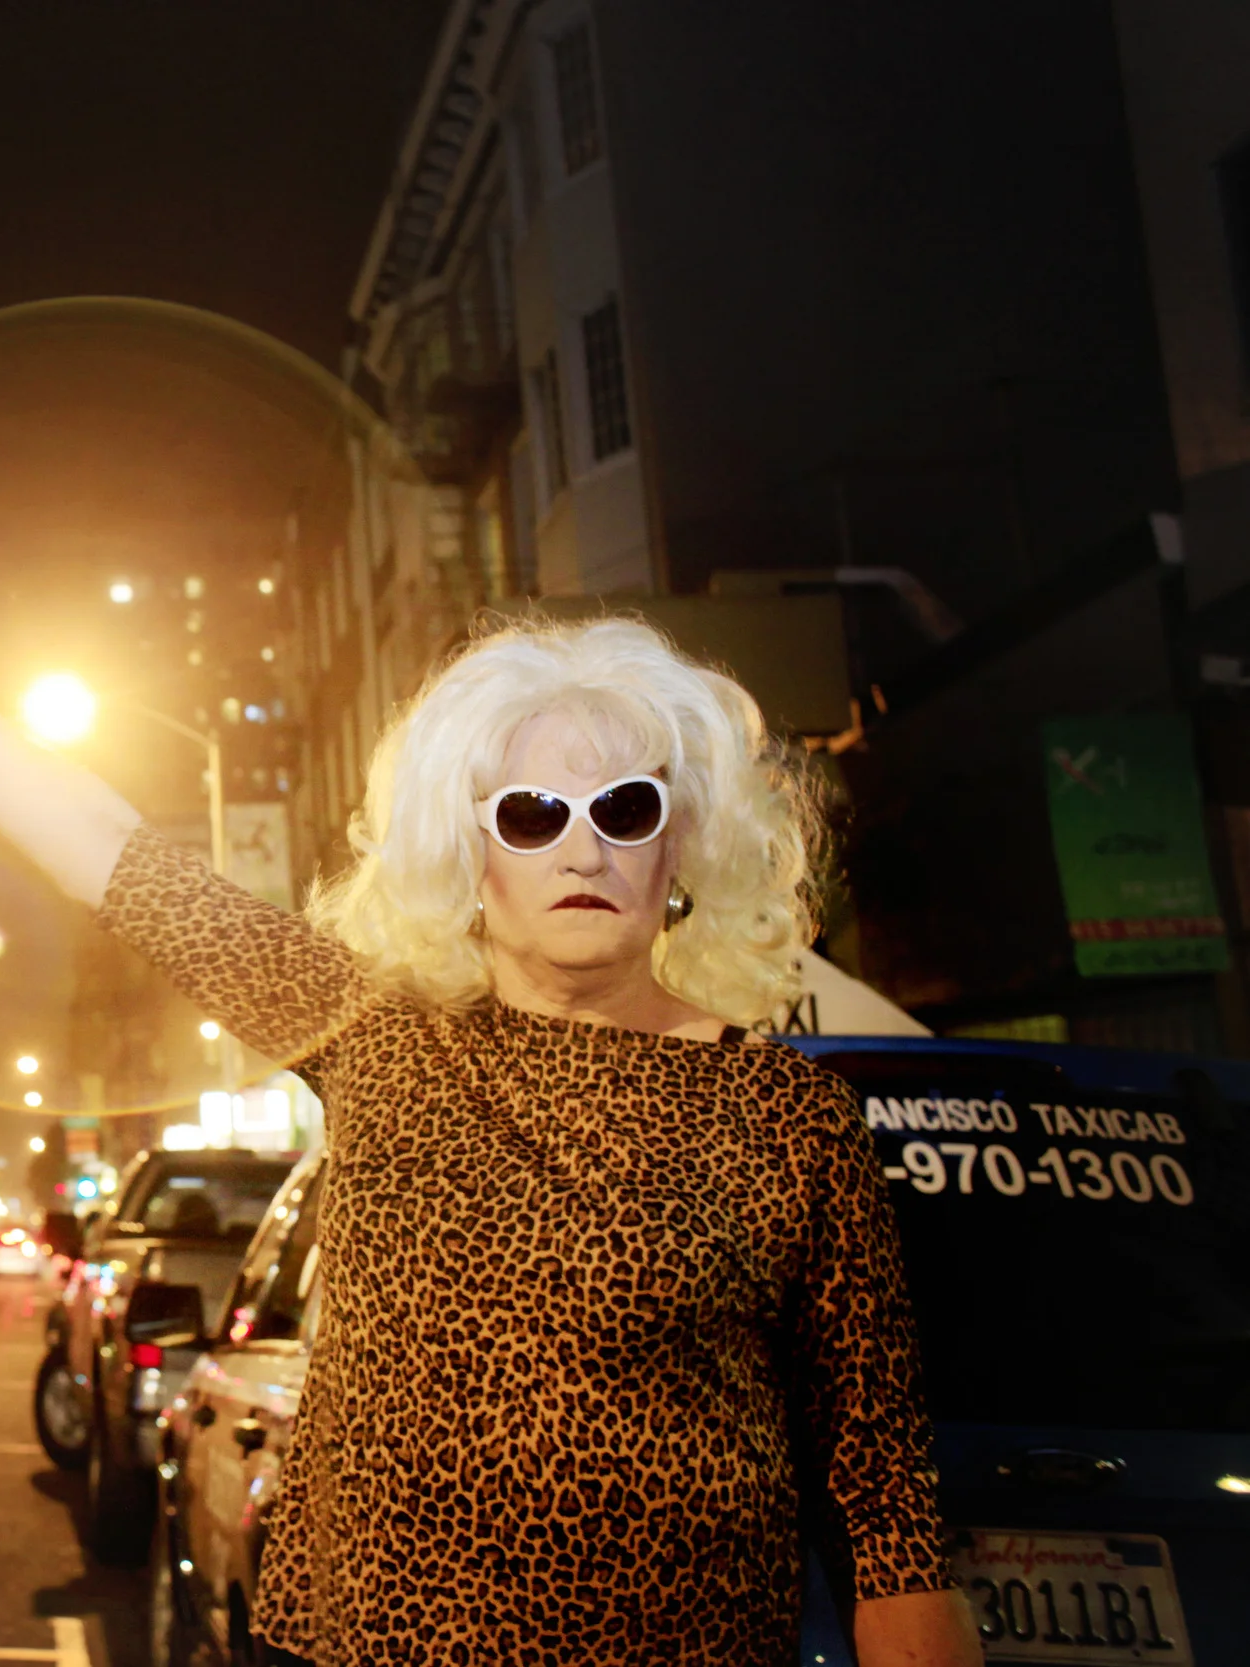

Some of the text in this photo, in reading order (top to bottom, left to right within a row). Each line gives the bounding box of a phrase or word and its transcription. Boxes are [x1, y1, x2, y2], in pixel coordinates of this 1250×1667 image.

[767, 993, 819, 1036] XI
[865, 1096, 1187, 1145] ANCISCO TAXICAB
[882, 1141, 1195, 1207] -970-1300
[968, 1534, 1126, 1575] California
[971, 1577, 1174, 1649] 3011B1
